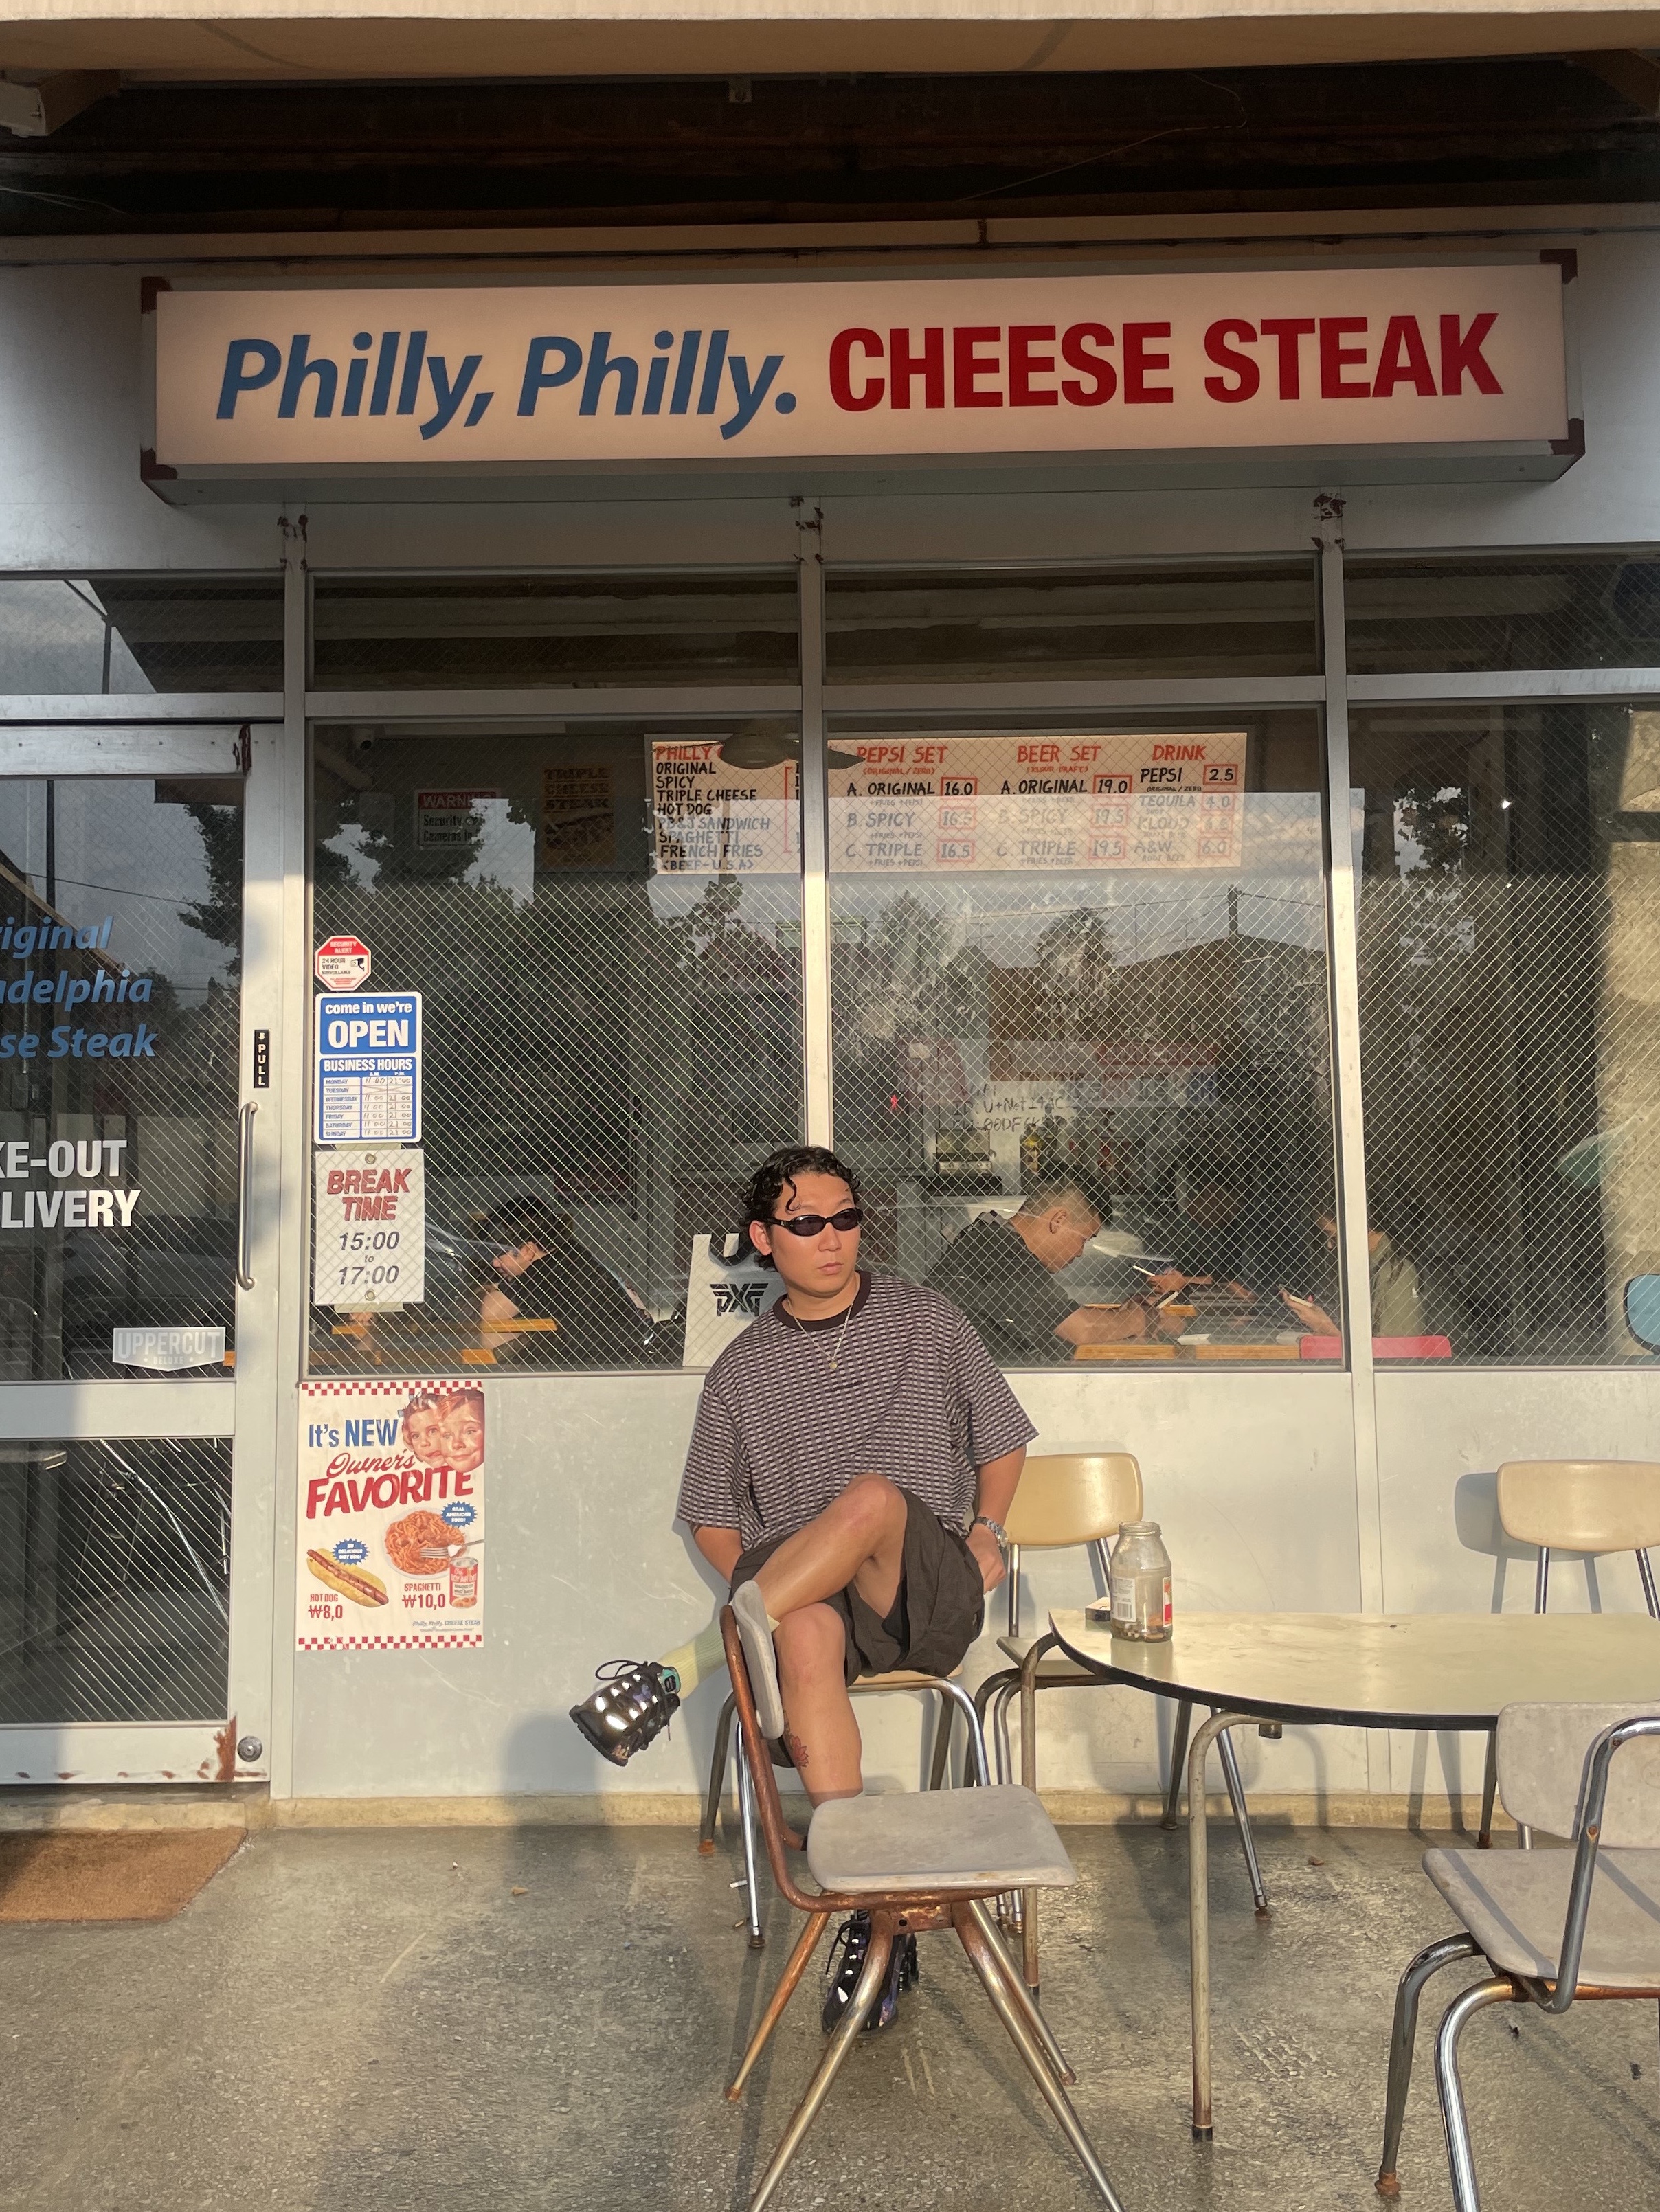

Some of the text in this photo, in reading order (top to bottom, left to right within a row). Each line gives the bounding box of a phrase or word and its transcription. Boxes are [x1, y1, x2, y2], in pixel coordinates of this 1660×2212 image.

[216, 313, 1503, 440] Philly, Philly. CHEESE STEAK
[655, 745, 710, 760] PHILLY
[857, 746, 948, 764] PEPSI SET
[1017, 745, 1101, 763] BEER SET
[1152, 745, 1207, 761] DRINK
[656, 762, 716, 774] ORIGINAL
[1141, 767, 1234, 782] PEPSI 2.5
[656, 776, 695, 789] SPICY
[846, 782, 973, 796] A. ORIGINAL 16.0
[1001, 779, 1128, 795] A. ORIGINAL 19.0
[657, 790, 756, 801] TRIPLE CHEESE
[1139, 795, 1196, 807] TEQUILA
[657, 803, 713, 815] HOT DOG
[1019, 809, 1068, 824] SPICY
[1095, 809, 1123, 824] 19.5
[698, 817, 770, 830] SANDWICH
[866, 812, 916, 828] SPICY
[659, 831, 739, 844] SPAGHETTI
[661, 844, 763, 857] FRENCH FRIES
[866, 844, 922, 857] TRIPLE
[941, 844, 970, 858] 16.5
[1018, 840, 1076, 856] TRIPLE
[1092, 840, 1122, 857] 19.5
[0, 916, 113, 959] iginal
[325, 1002, 412, 1015] come in we're
[47, 1023, 158, 1058] Steak
[328, 1019, 409, 1048] OPEN
[258, 1043, 267, 1085] PULL
[324, 1059, 412, 1072] BUSINESS HOURS
[327, 1169, 412, 1194] BREAK
[1, 1189, 141, 1228] LIVERY
[342, 1196, 398, 1221] TIME
[339, 1231, 400, 1251] 15:00
[364, 1254, 374, 1263] to
[339, 1265, 399, 1285] 17:00
[118, 1331, 221, 1359] UPPERCUT
[153, 1356, 184, 1366] DELUXE
[309, 1419, 398, 1447] It's NEW
[326, 1448, 416, 1478] Owner's
[306, 1465, 474, 1519] FAVORITE
[404, 1583, 441, 1592] SPAGHETTI
[310, 1594, 339, 1602] HOT DOG
